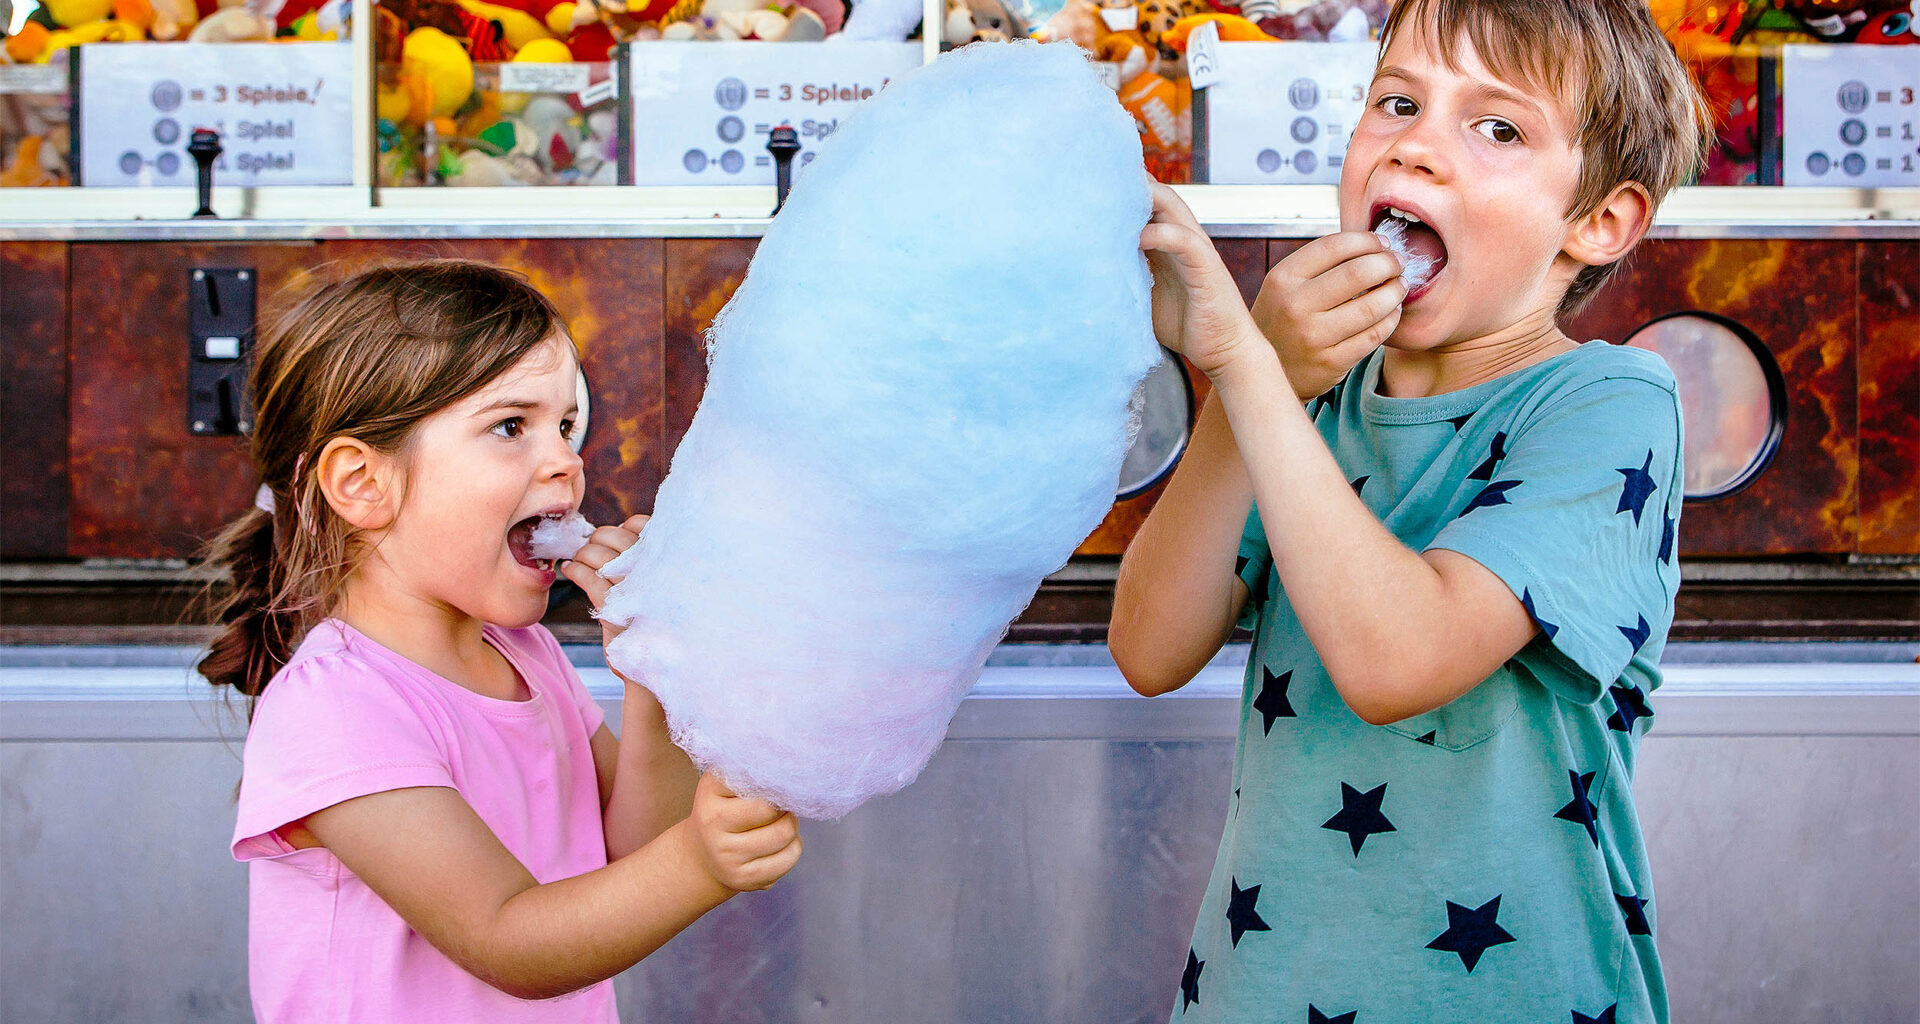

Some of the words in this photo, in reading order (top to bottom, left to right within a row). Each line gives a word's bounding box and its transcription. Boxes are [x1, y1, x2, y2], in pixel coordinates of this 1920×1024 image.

[215, 85, 227, 103] 3
[779, 84, 792, 101] 3
[1351, 84, 1365, 102] 3
[1900, 86, 1914, 105] 3
[238, 119, 294, 141] Spiel
[1901, 122, 1914, 140] 1
[238, 151, 294, 173] Spiel
[1901, 154, 1914, 172] 1
